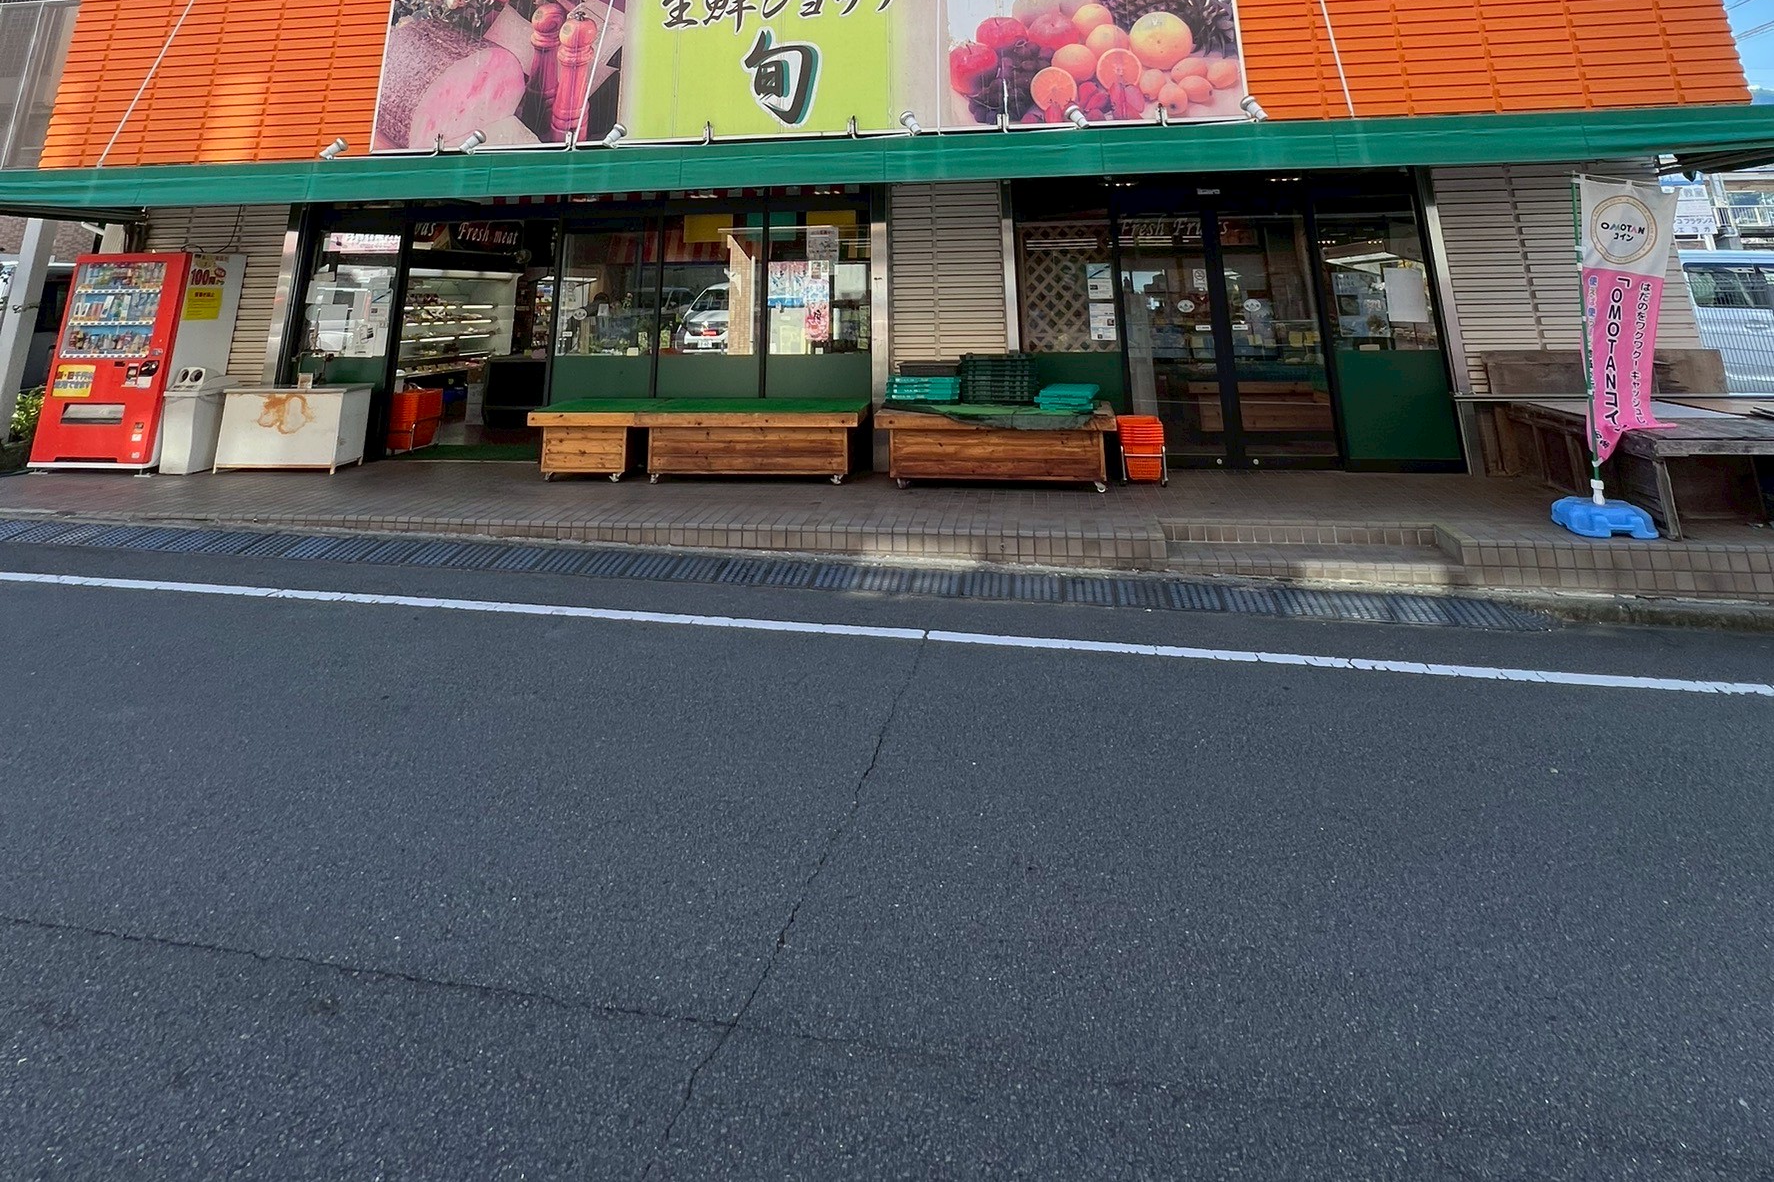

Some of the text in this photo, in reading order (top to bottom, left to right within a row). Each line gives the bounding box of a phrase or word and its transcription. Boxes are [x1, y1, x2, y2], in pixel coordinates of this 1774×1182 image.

[744, 29, 820, 125] 旬
[457, 221, 519, 246] Fresh meat
[1120, 219, 1165, 236] Fresh
[1601, 221, 1646, 235] OMOTAN
[1613, 232, 1634, 242] コイン
